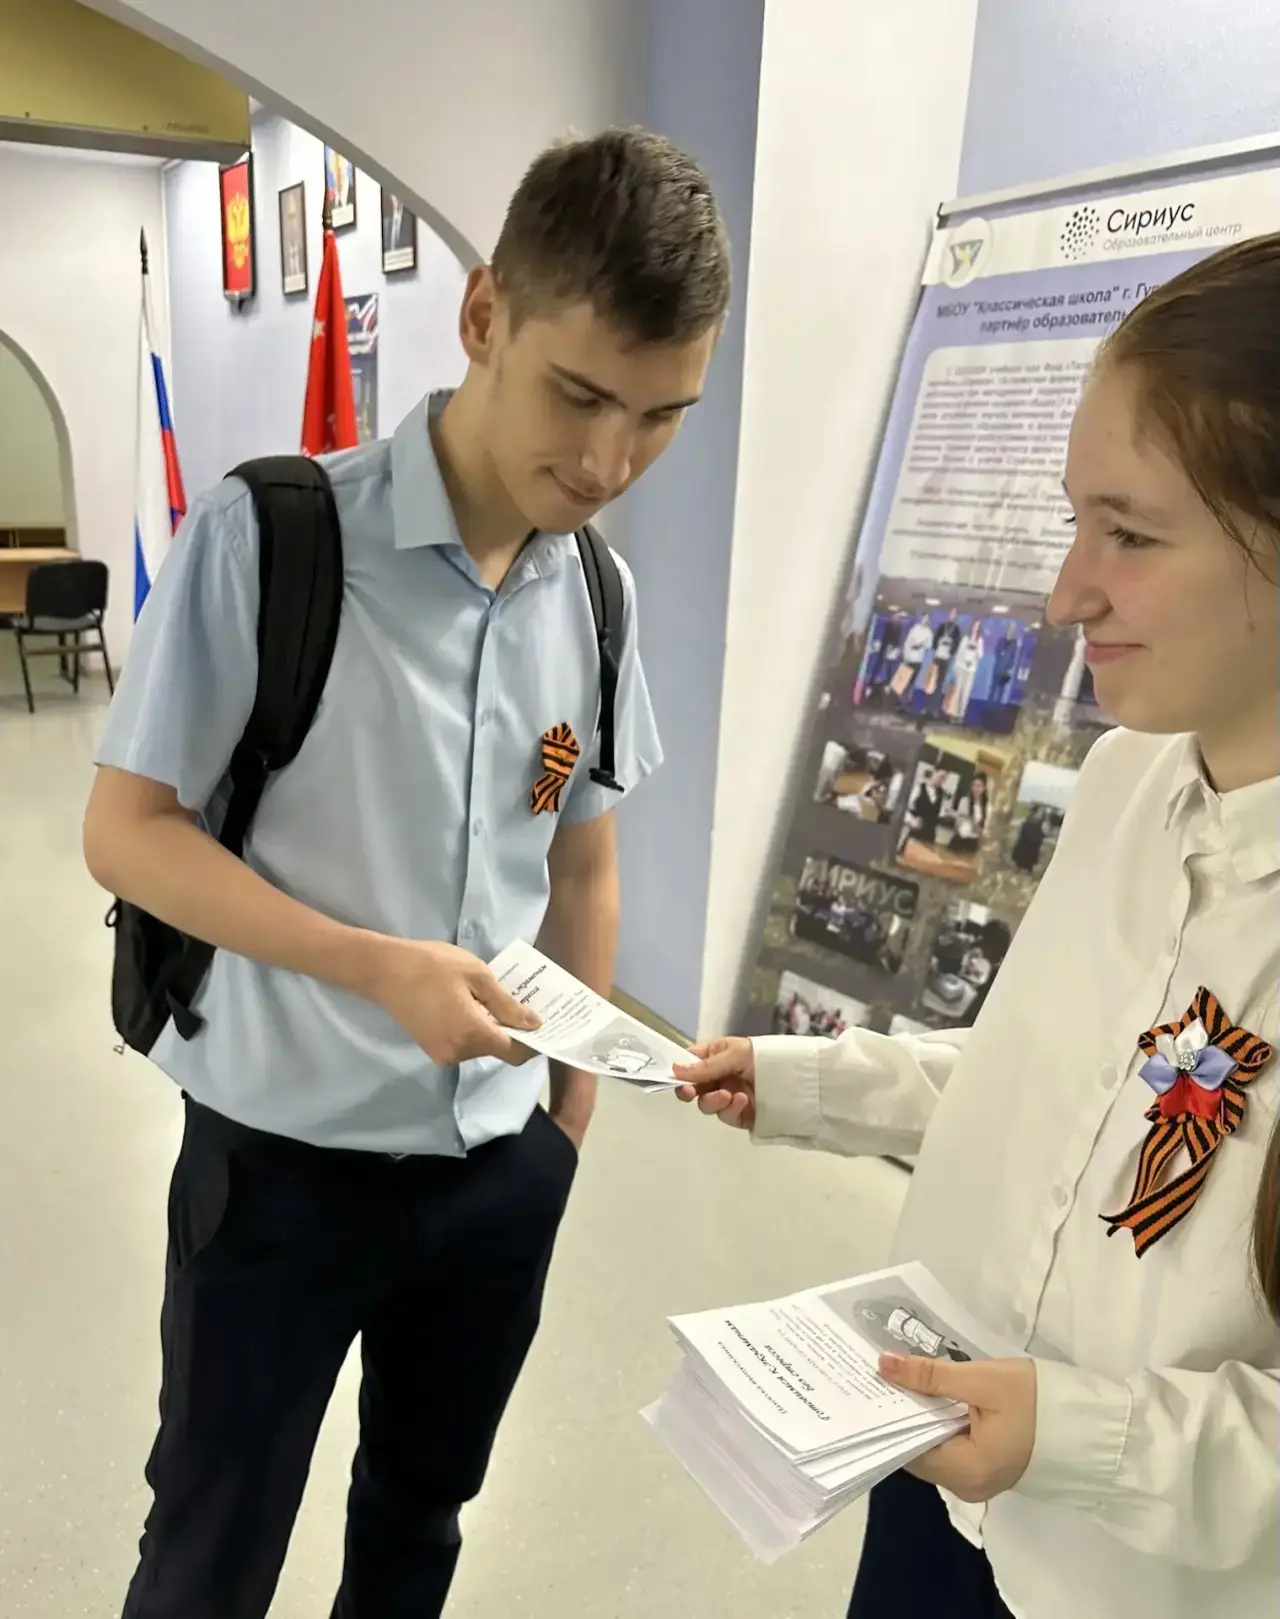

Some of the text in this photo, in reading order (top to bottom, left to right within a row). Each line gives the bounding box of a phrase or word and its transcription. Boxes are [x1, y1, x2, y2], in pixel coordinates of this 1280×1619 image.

[1107, 203, 1195, 235] Сириус
[1102, 223, 1242, 252] Образовательный центр
[1068, 287, 1119, 306] школа"
[1123, 285, 1131, 299] г.
